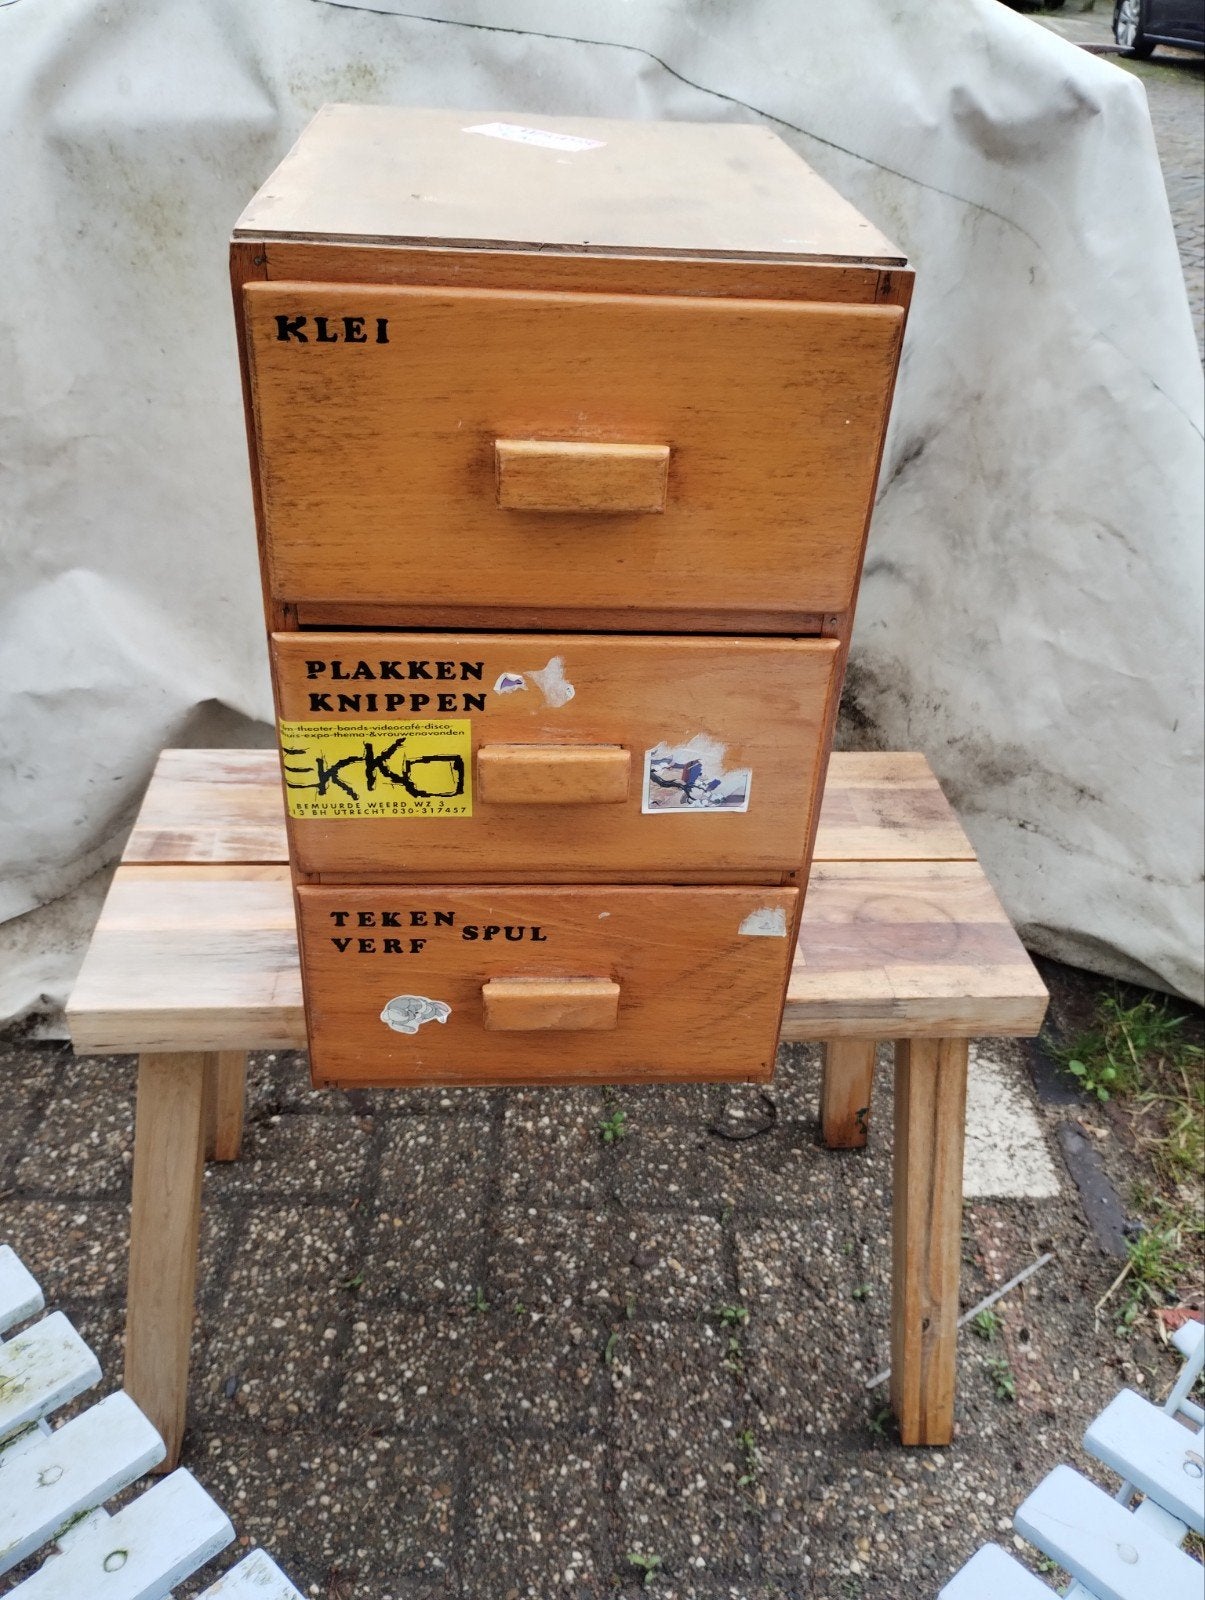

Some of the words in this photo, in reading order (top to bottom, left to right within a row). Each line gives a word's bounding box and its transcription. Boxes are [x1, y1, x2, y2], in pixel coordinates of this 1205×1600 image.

[274, 315, 390, 344] KLEI
[305, 660, 485, 681] PLAKKEN
[308, 693, 487, 712] KNIPPEN
[296, 802, 361, 810] BEMUURDE
[367, 801, 407, 809] WEERD
[334, 808, 385, 816] UTRECHT
[392, 807, 466, 815] 030-317457
[330, 911, 456, 927] TEKEN
[331, 938, 427, 954] VERF
[461, 926, 548, 942] SPUL
